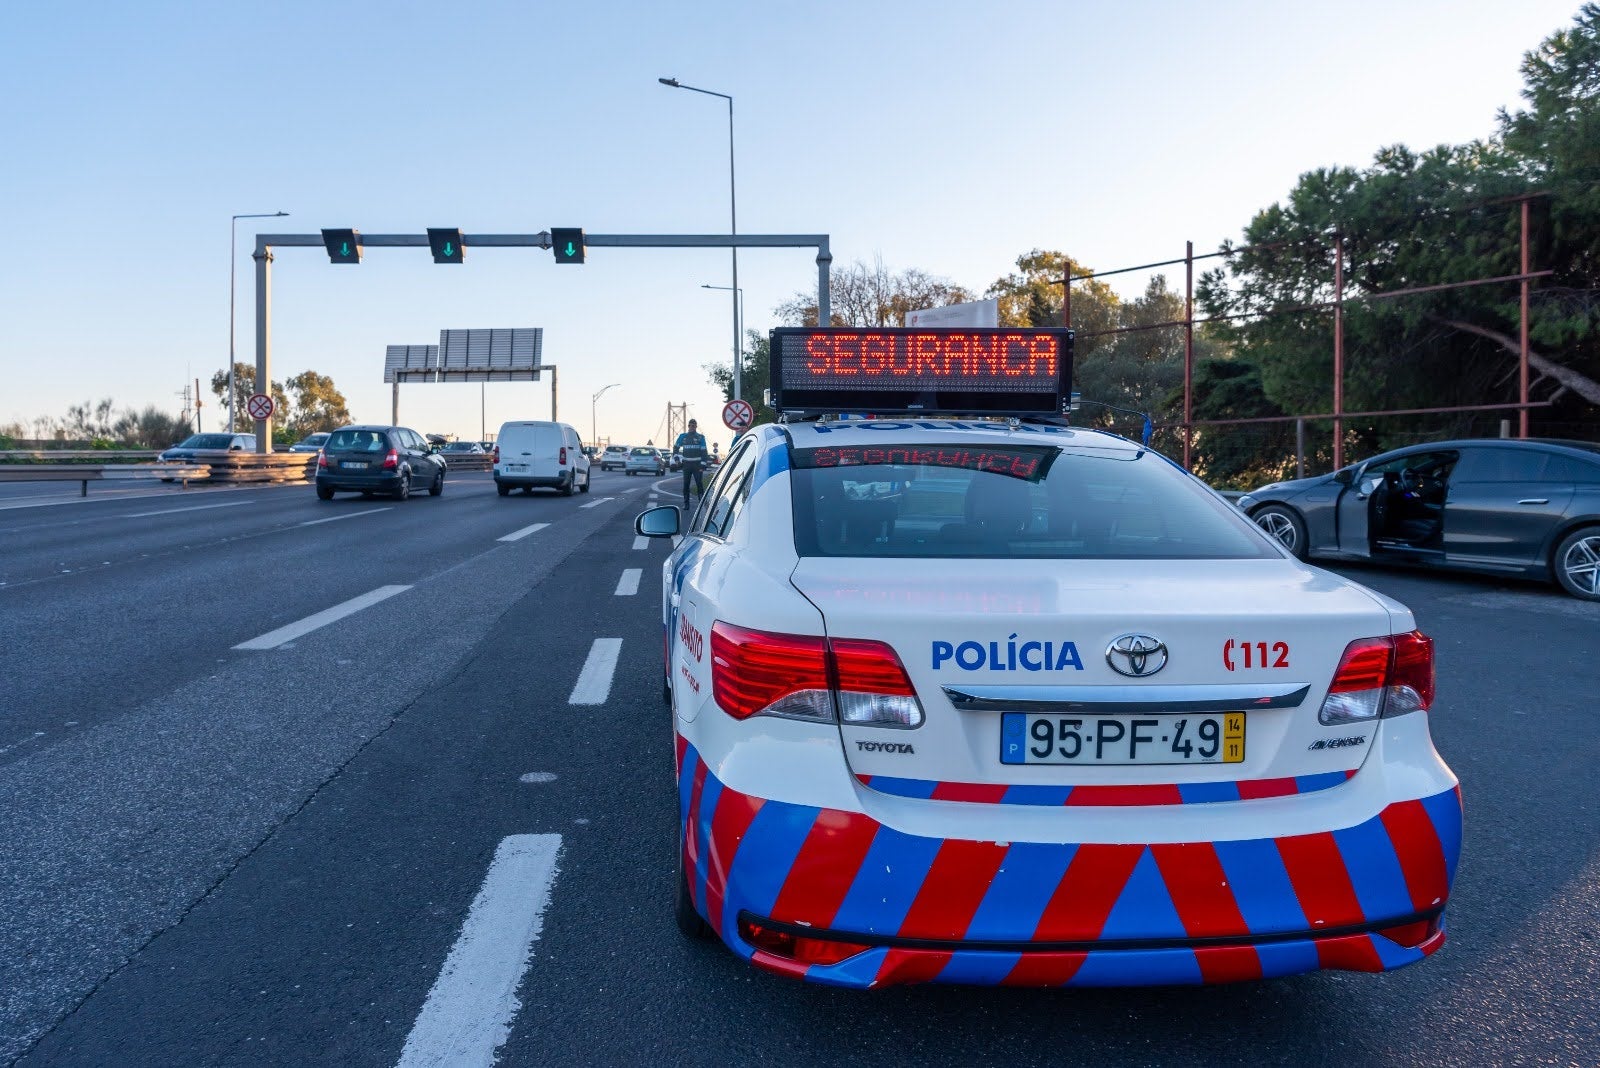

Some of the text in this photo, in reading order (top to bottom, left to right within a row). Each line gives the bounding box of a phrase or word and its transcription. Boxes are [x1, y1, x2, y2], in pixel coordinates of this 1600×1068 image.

[806, 333, 1058, 376] SEGURANCA
[932, 633, 1085, 672] POLÍCIA
[1240, 641, 1290, 669] 112
[1228, 718, 1241, 732] 14
[855, 740, 916, 755] TOYOTA
[1009, 743, 1019, 755] P
[1229, 744, 1239, 757] 11
